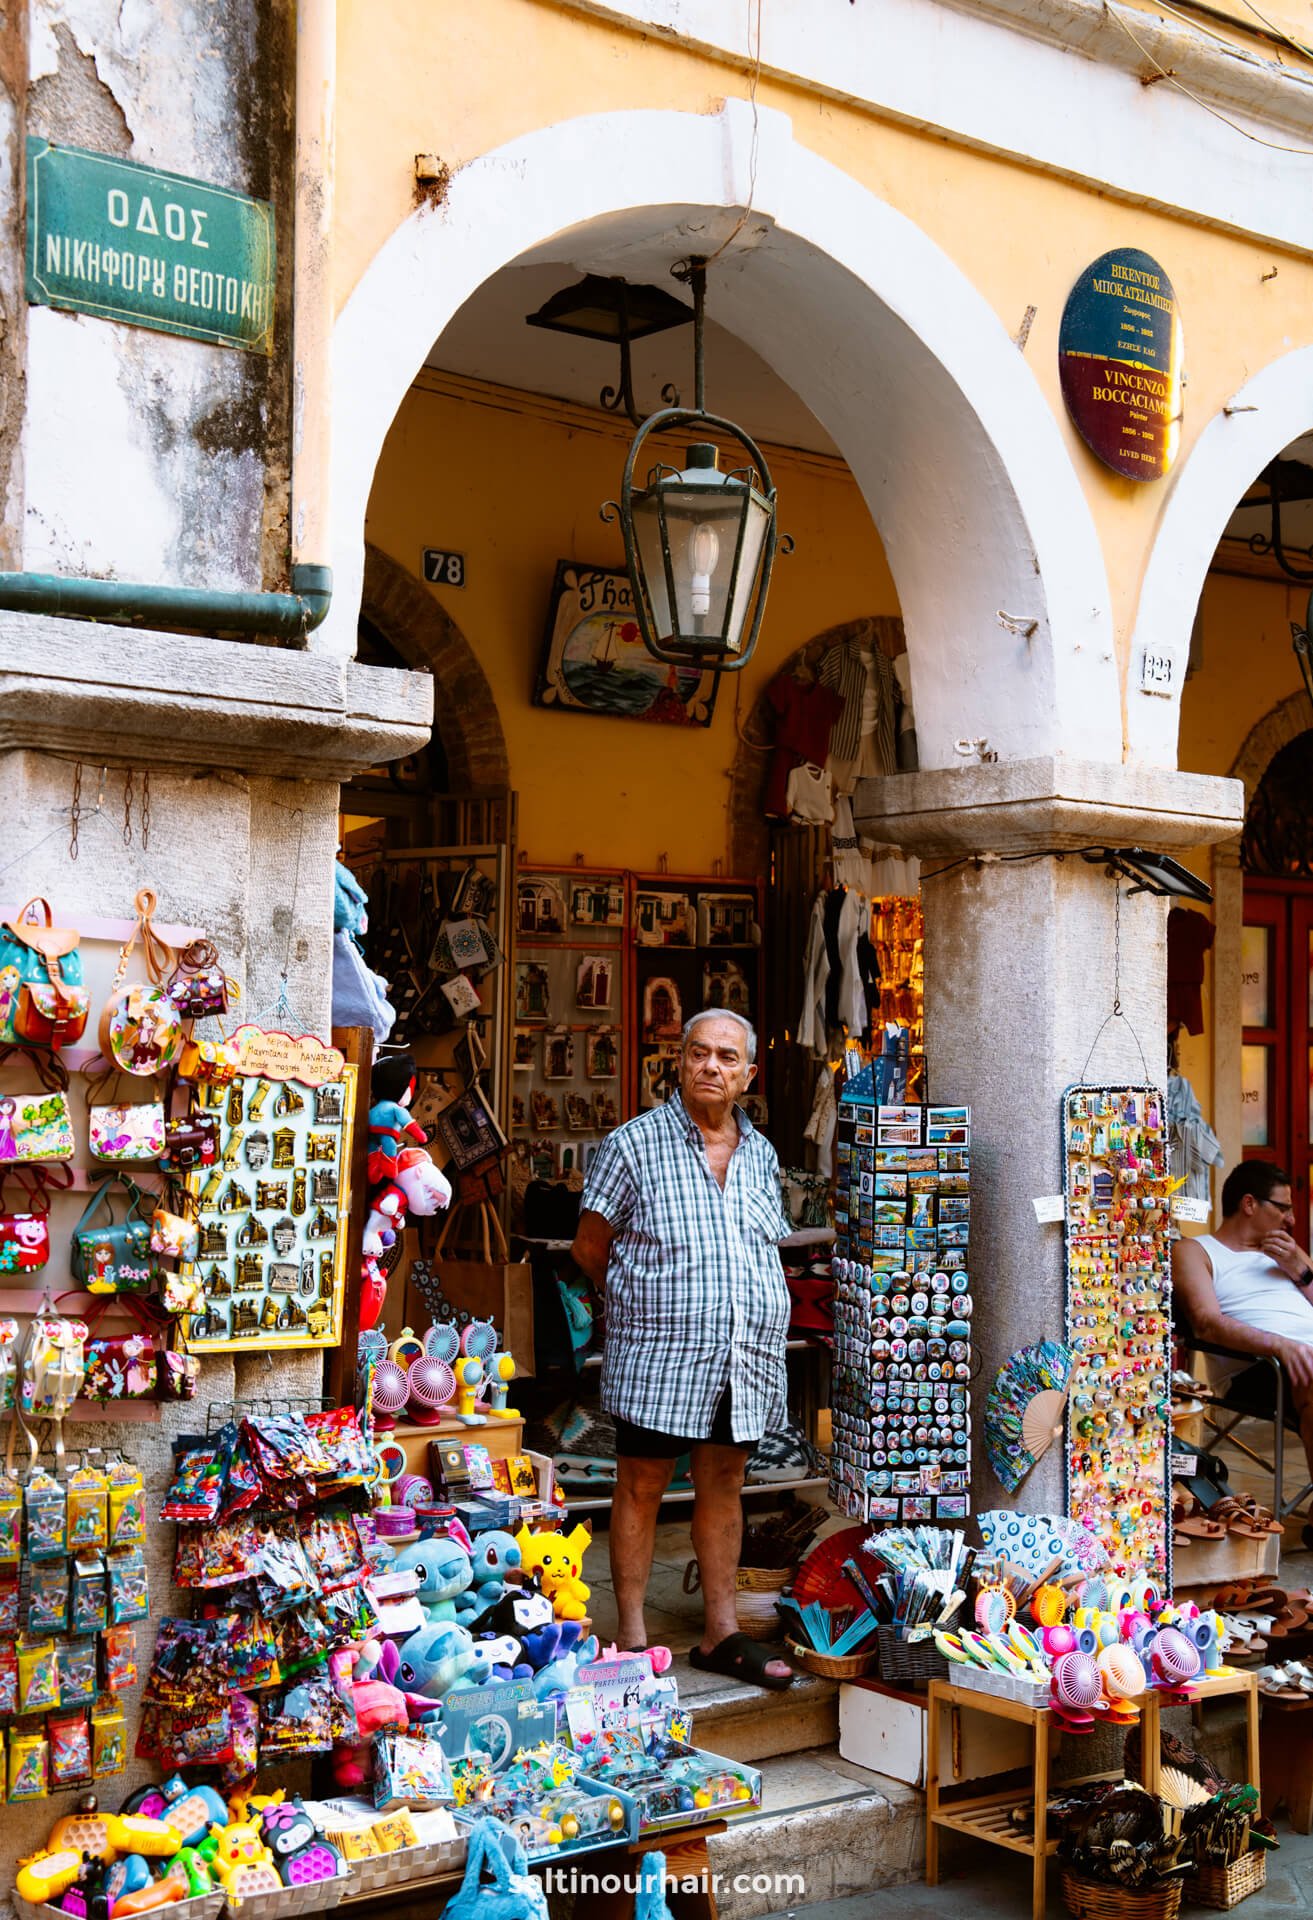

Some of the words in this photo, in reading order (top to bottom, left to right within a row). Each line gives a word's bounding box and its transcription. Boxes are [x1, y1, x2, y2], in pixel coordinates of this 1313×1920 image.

[107, 189, 209, 249] ΟΔΟΣ
[1104, 369, 1166, 397] VINCENZO
[1119, 448, 1140, 460] LIVED
[430, 553, 461, 583] 78
